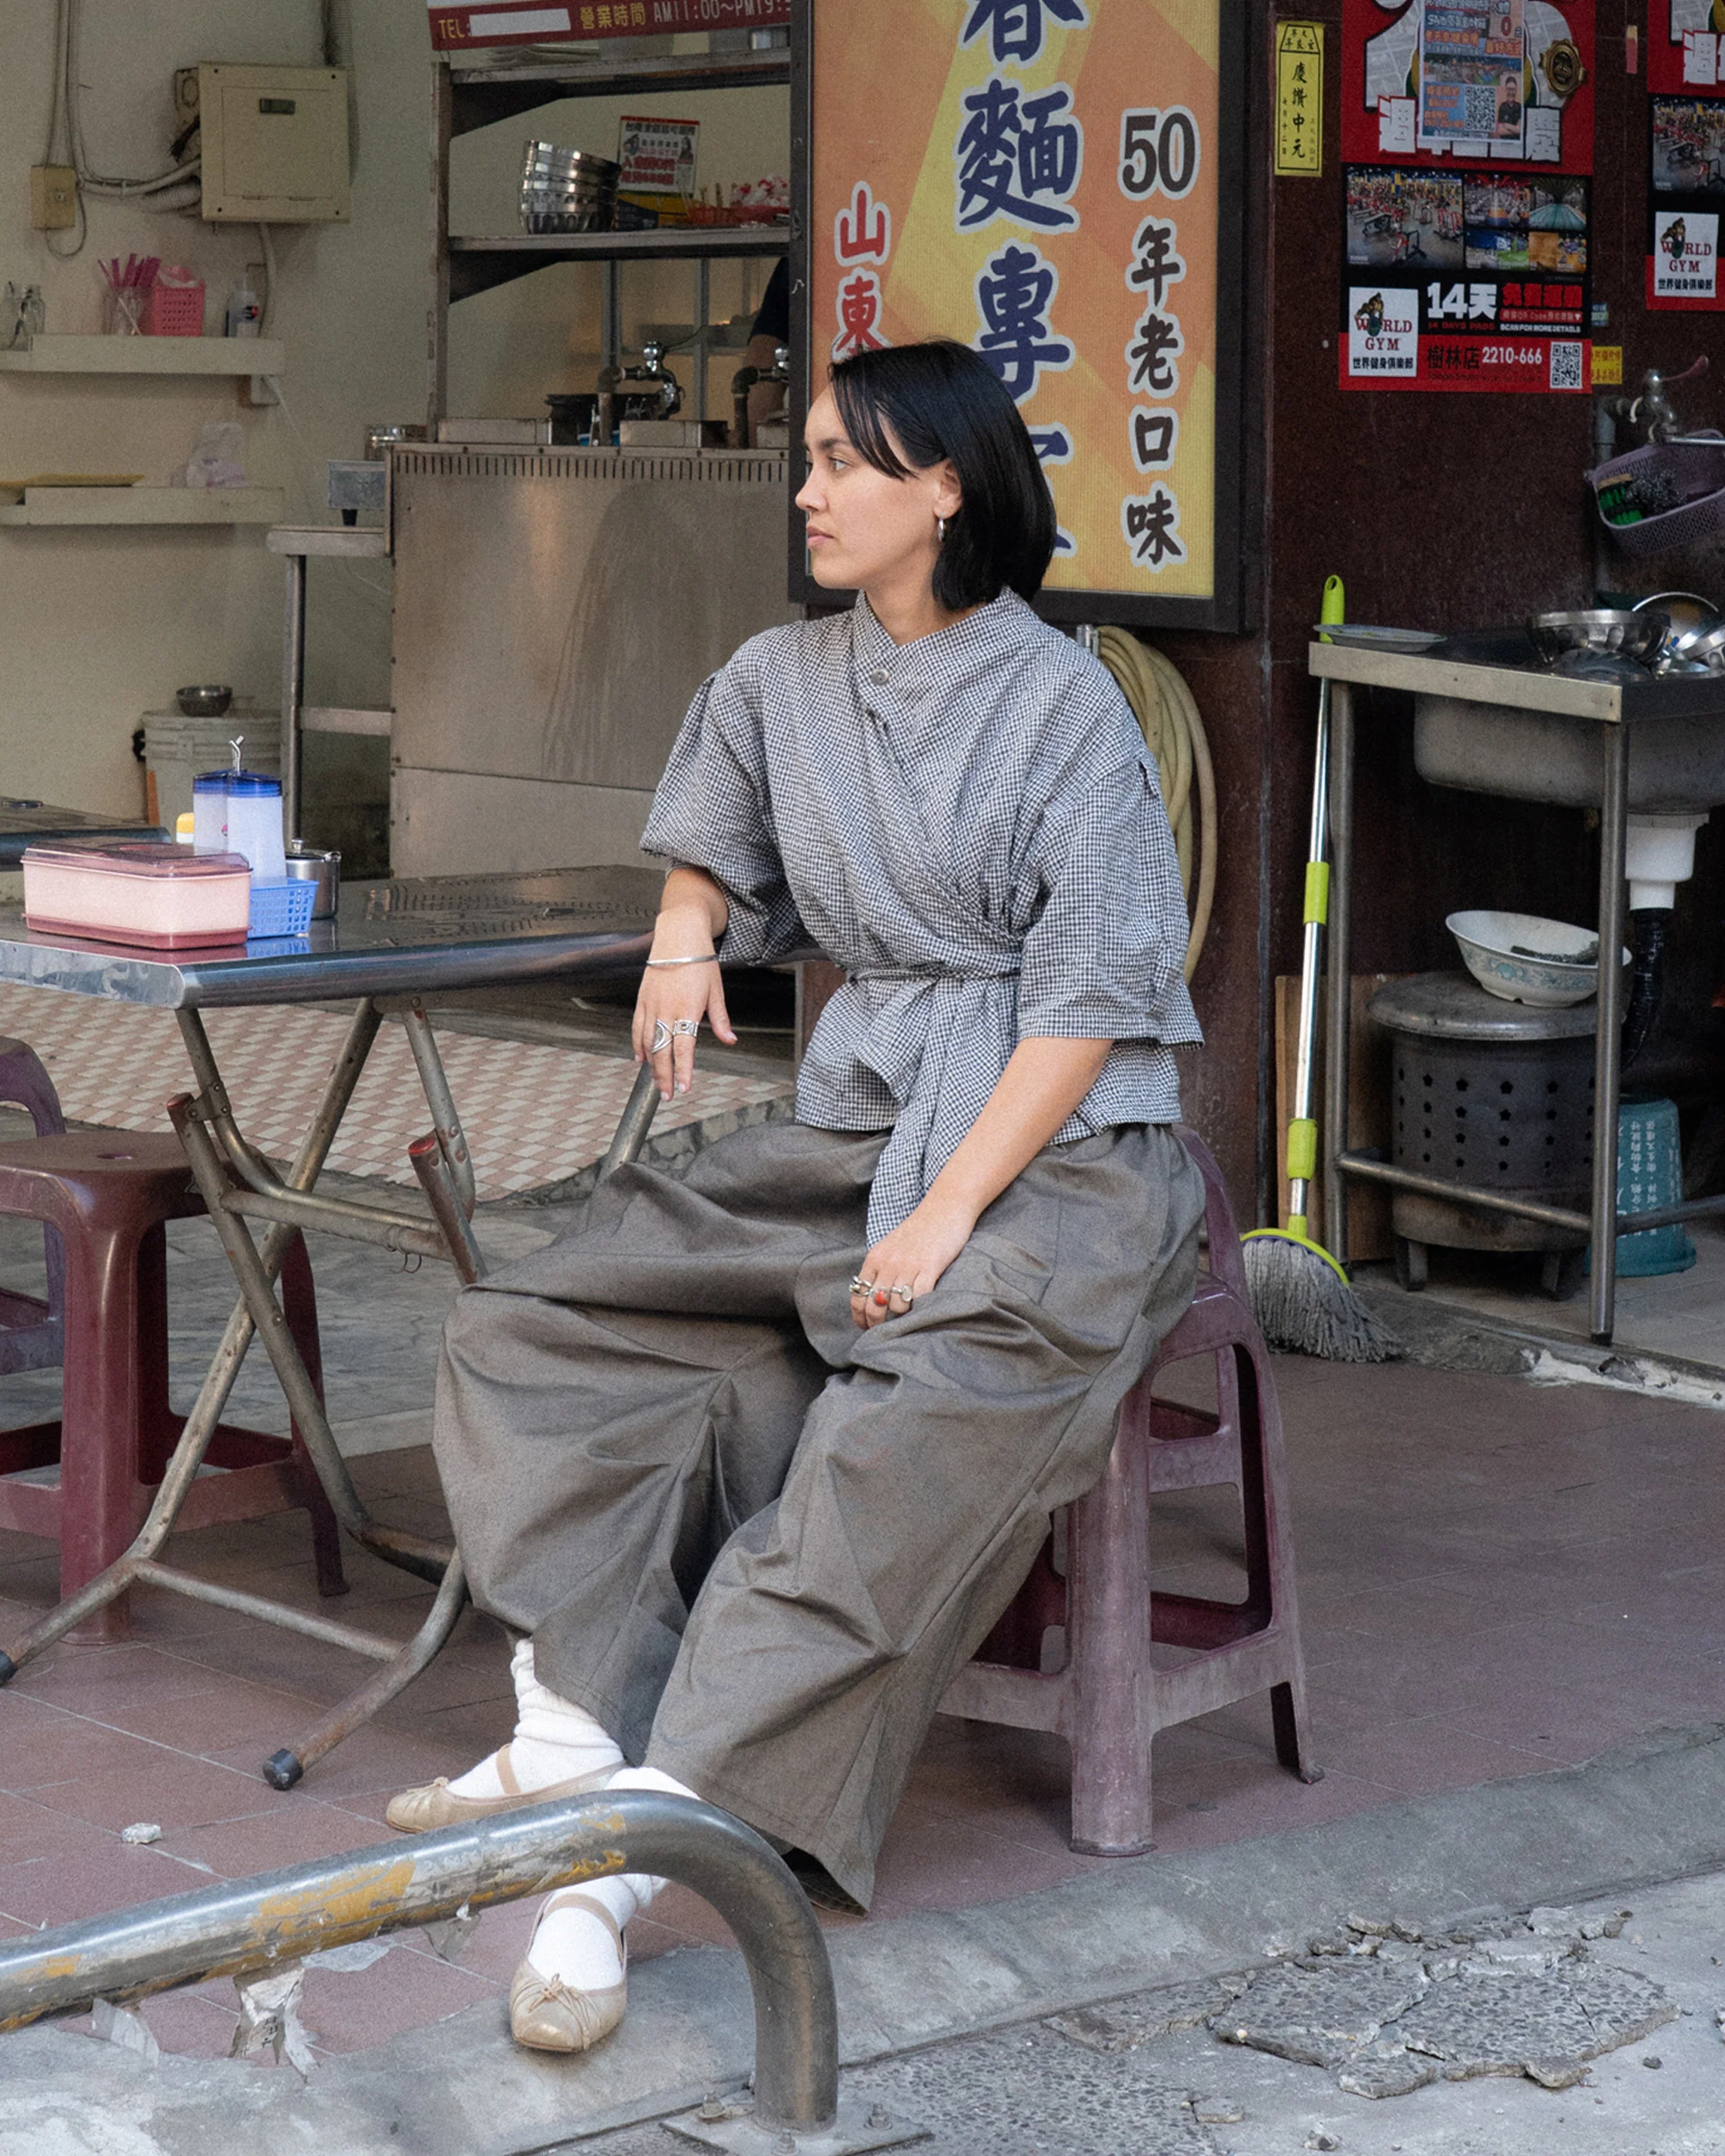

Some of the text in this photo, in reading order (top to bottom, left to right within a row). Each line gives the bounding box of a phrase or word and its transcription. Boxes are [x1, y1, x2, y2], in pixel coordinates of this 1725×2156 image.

[580, 3, 645, 29] 營業時間
[837, 189, 885, 354] 山東
[958, 0, 1084, 549] 麵專
[1669, 260, 1700, 273] GYM
[1658, 279, 1713, 291] 世界健身俱樂部
[1427, 282, 1497, 321] 14天
[1122, 112, 1196, 565] 50年老口味
[1519, 323, 1533, 332] FOR
[1533, 324, 1552, 333] MORE
[1552, 324, 1581, 334] DETAILS
[1364, 336, 1399, 352] GYM
[1352, 356, 1414, 370] 世界健身俱樂部
[1427, 346, 1543, 370] 樹林店 2210-666
